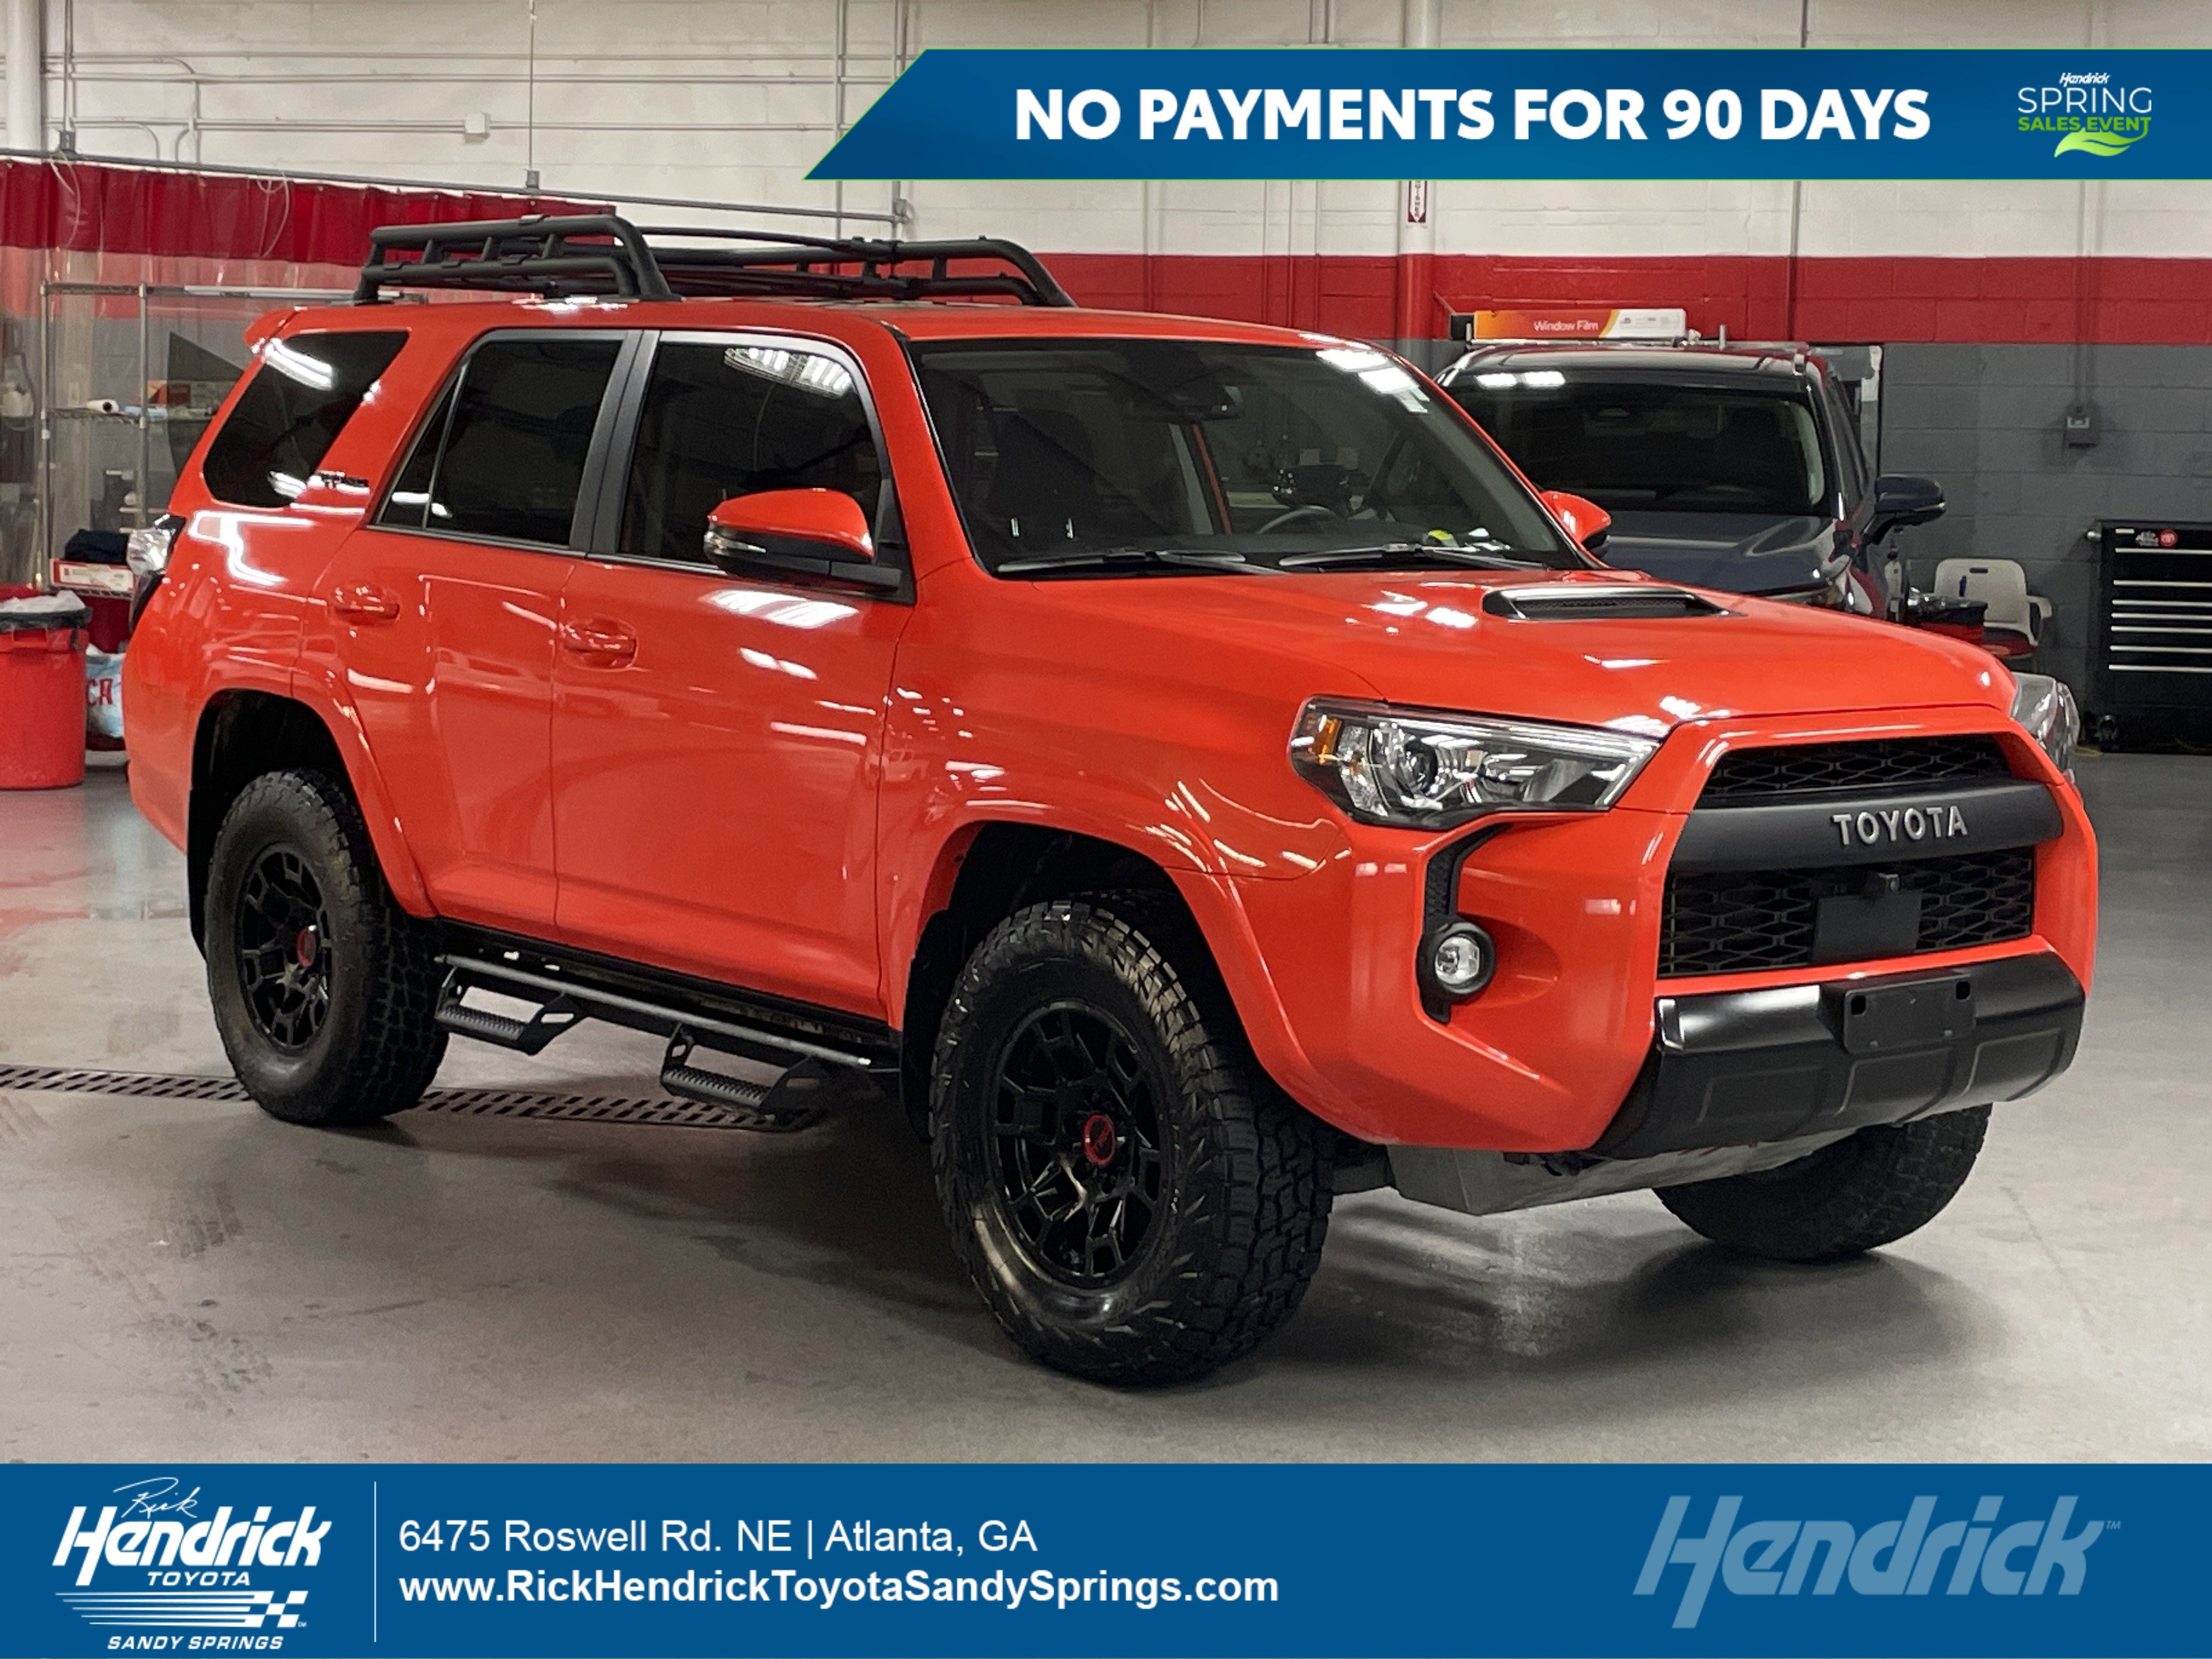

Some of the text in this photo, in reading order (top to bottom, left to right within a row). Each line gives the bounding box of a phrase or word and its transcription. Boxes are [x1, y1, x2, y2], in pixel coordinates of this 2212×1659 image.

[1533, 319, 1599, 331] Window Film
[1832, 805, 1968, 845] TOYOTA
